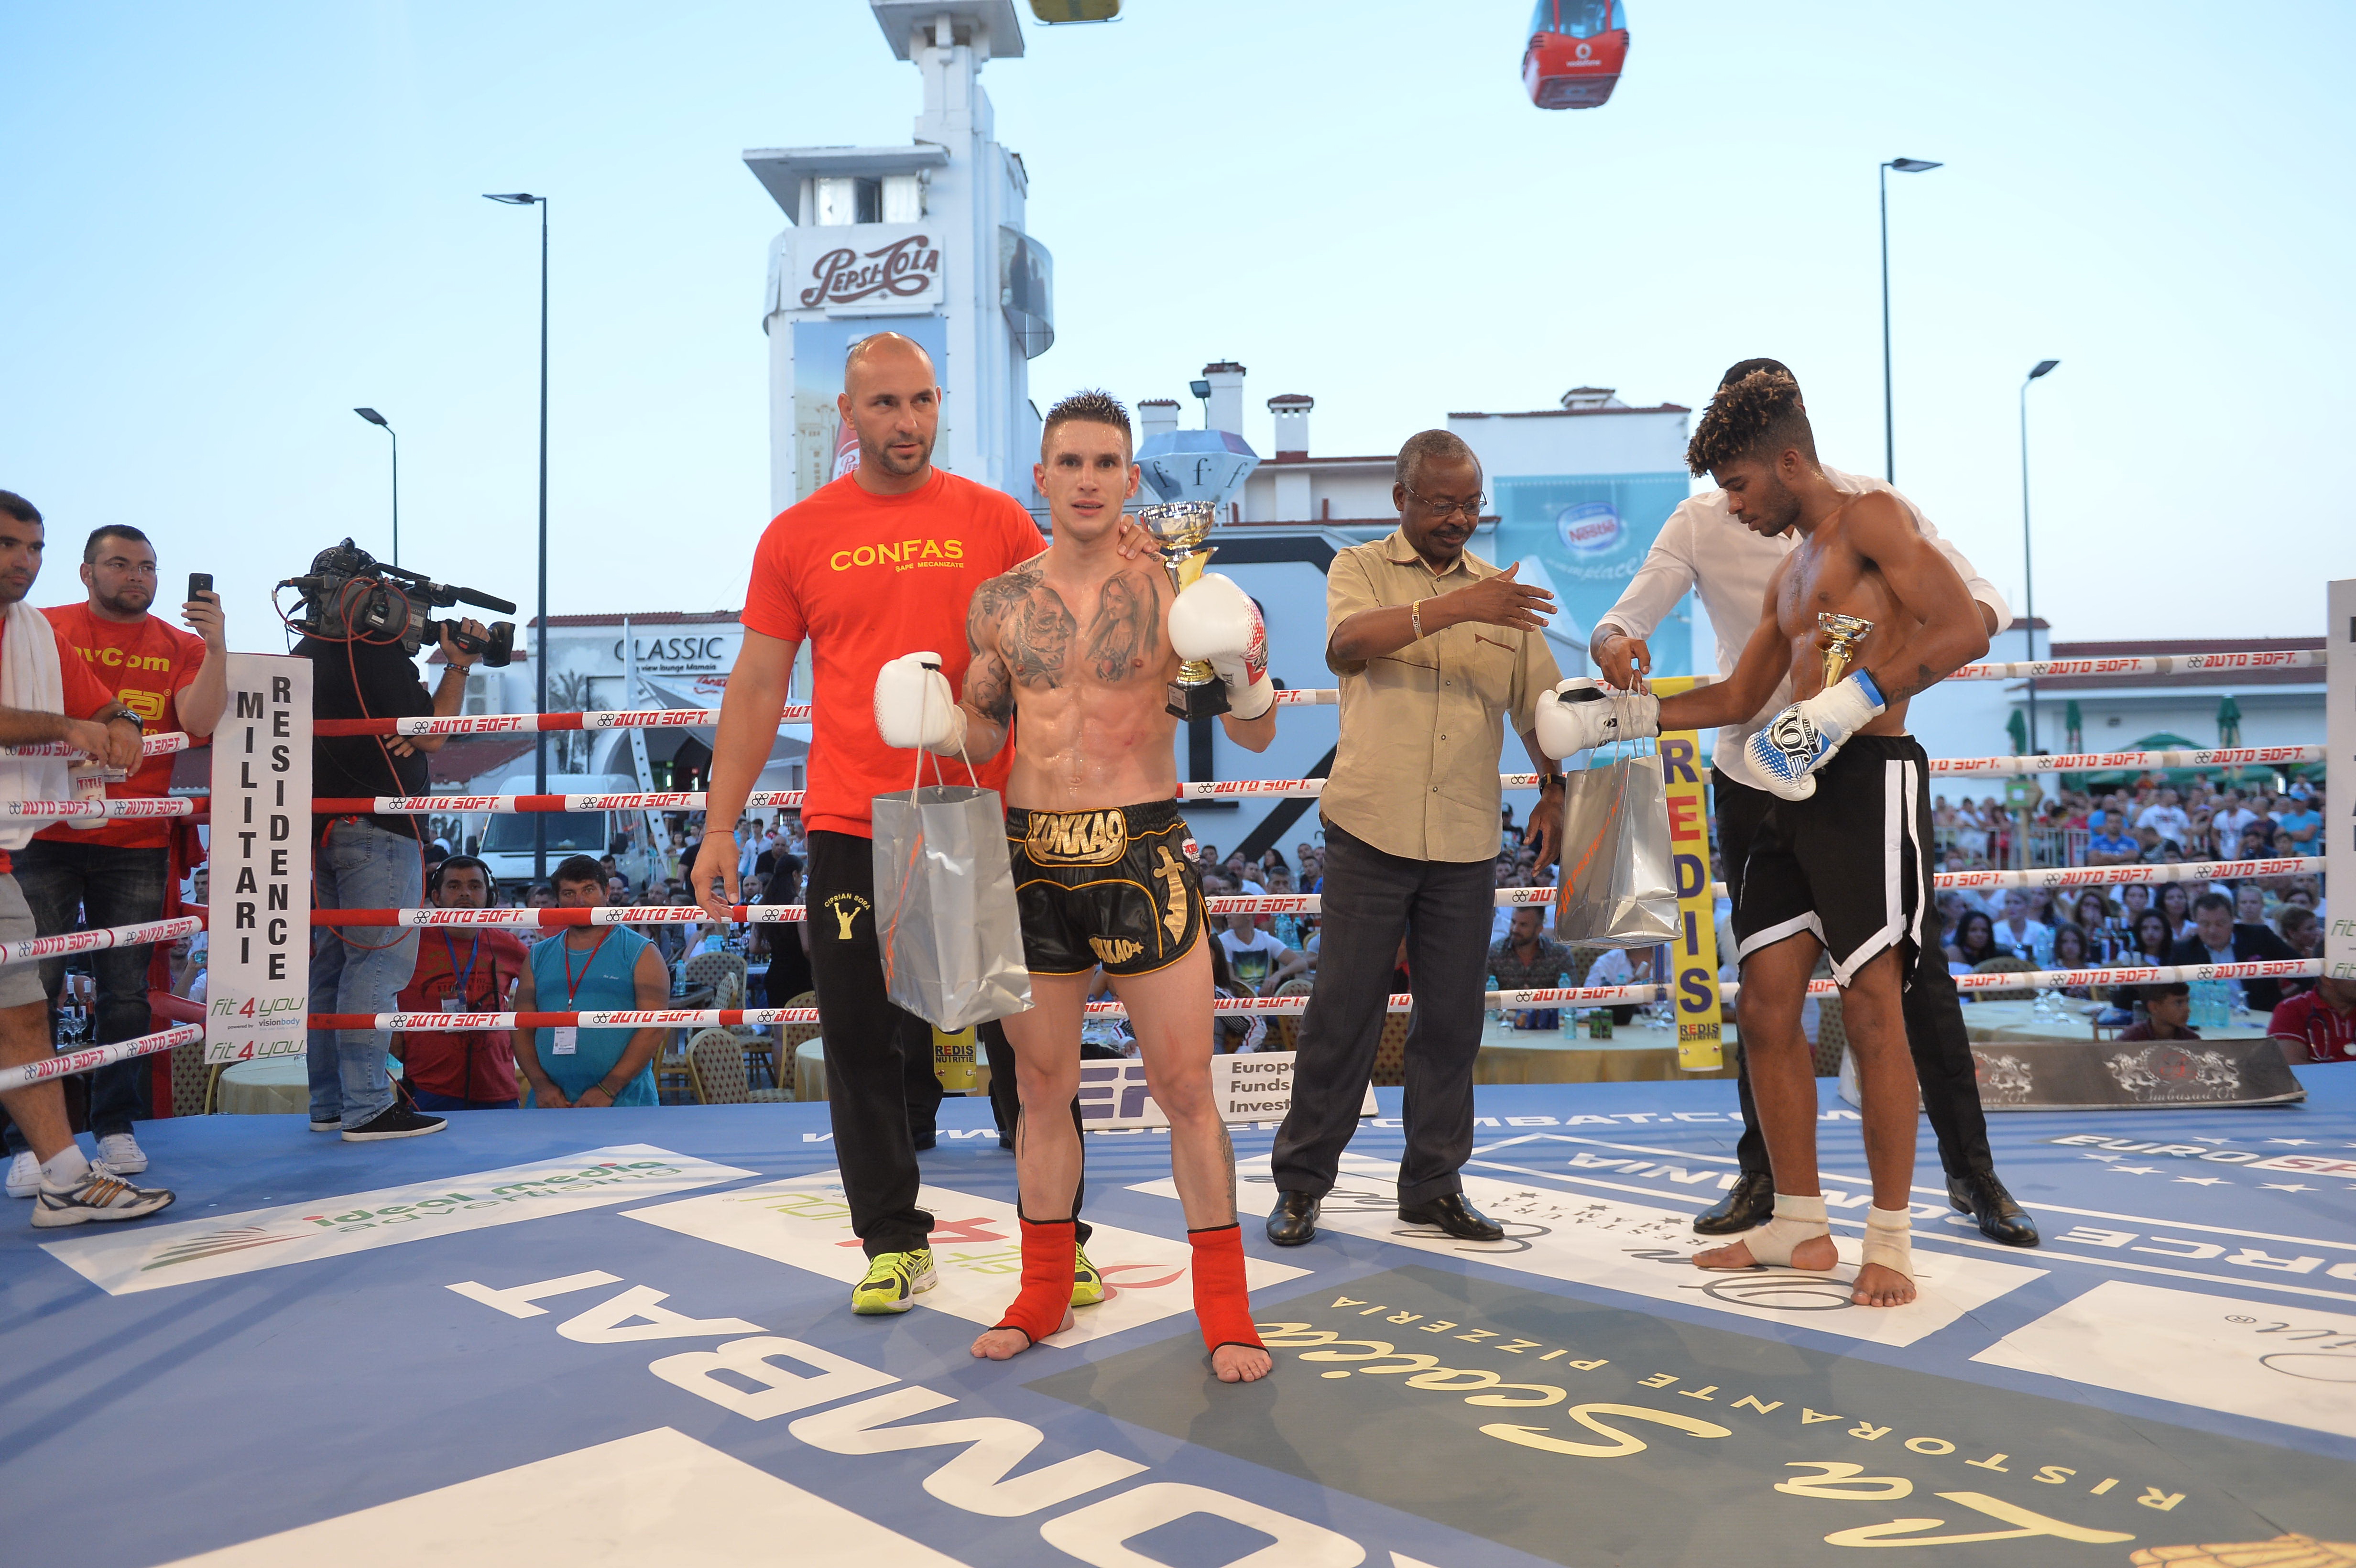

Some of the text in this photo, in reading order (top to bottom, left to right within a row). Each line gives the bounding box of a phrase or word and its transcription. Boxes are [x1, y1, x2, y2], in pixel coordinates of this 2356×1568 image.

[830, 539, 963, 571] CONFAS
[2048, 659, 2141, 674] AUTO SOFT
[2203, 652, 2296, 667] AUTO SOFT
[659, 664, 684, 672] lounge
[429, 718, 521, 733] AUTO SOFT
[614, 711, 708, 726] AUTO SOFT
[153, 738, 179, 754] SOFT
[2053, 752, 2147, 767] AUTO SOFT
[2211, 747, 2305, 762] AUTO SOFT
[1954, 757, 1999, 770] SOFT
[1214, 779, 1306, 793] AUTO SOFT
[22, 801, 91, 815] AUTO SOFT
[124, 801, 184, 815] AUTO SOFT
[405, 796, 499, 810] AUTO SOFT
[597, 794, 690, 808] AUTO SOFT
[236, 691, 263, 964] MILITARI
[268, 676, 292, 980] RESIDENCE
[1030, 809, 1124, 862] YOKKAO
[1660, 739, 1712, 1014] REDIS
[2059, 868, 2152, 885] AUTO SOFT
[2210, 860, 2304, 878] AUTO SOFT
[1958, 873, 2004, 885] SOFT
[824, 893, 871, 910] CIPRIAN SORA
[1211, 899, 1306, 913] AUTO SOFT
[429, 910, 523, 924] AUTO SOFT
[622, 909, 670, 921] AUTO
[134, 920, 193, 944] AUTO SOFT
[32, 933, 99, 956] AUTO SOFT
[2065, 969, 2160, 984] AUTO SOFT
[2214, 961, 2306, 978] AUTO SOFT
[1963, 975, 2009, 987] SOFT
[1533, 987, 1626, 1001] AUTO SOFT
[211, 997, 305, 1018] fit 4 you
[1257, 997, 1302, 1008] SOFT
[259, 1017, 300, 1026] visionbody
[407, 1014, 501, 1027] AUTO SOFT
[611, 1010, 704, 1024] AUTO SOFT
[1680, 1023, 1719, 1034] REDIS
[137, 1029, 194, 1055] AUTO SOFT
[209, 1040, 304, 1060] fit 4 you
[935, 1045, 974, 1056] REDIS
[38, 1050, 105, 1078] AUTO SOFT
[935, 1056, 974, 1065] NUTRITIE
[1231, 1079, 1289, 1093] Funds
[303, 1161, 668, 1227] ideal media
[338, 1166, 682, 1233] advertising
[1331, 1296, 1609, 1372] PIZZERIA
[445, 1269, 1439, 1568] OMBAT
[1636, 1372, 2188, 1513] RISTORANTE
[1773, 1461, 2137, 1547] La
